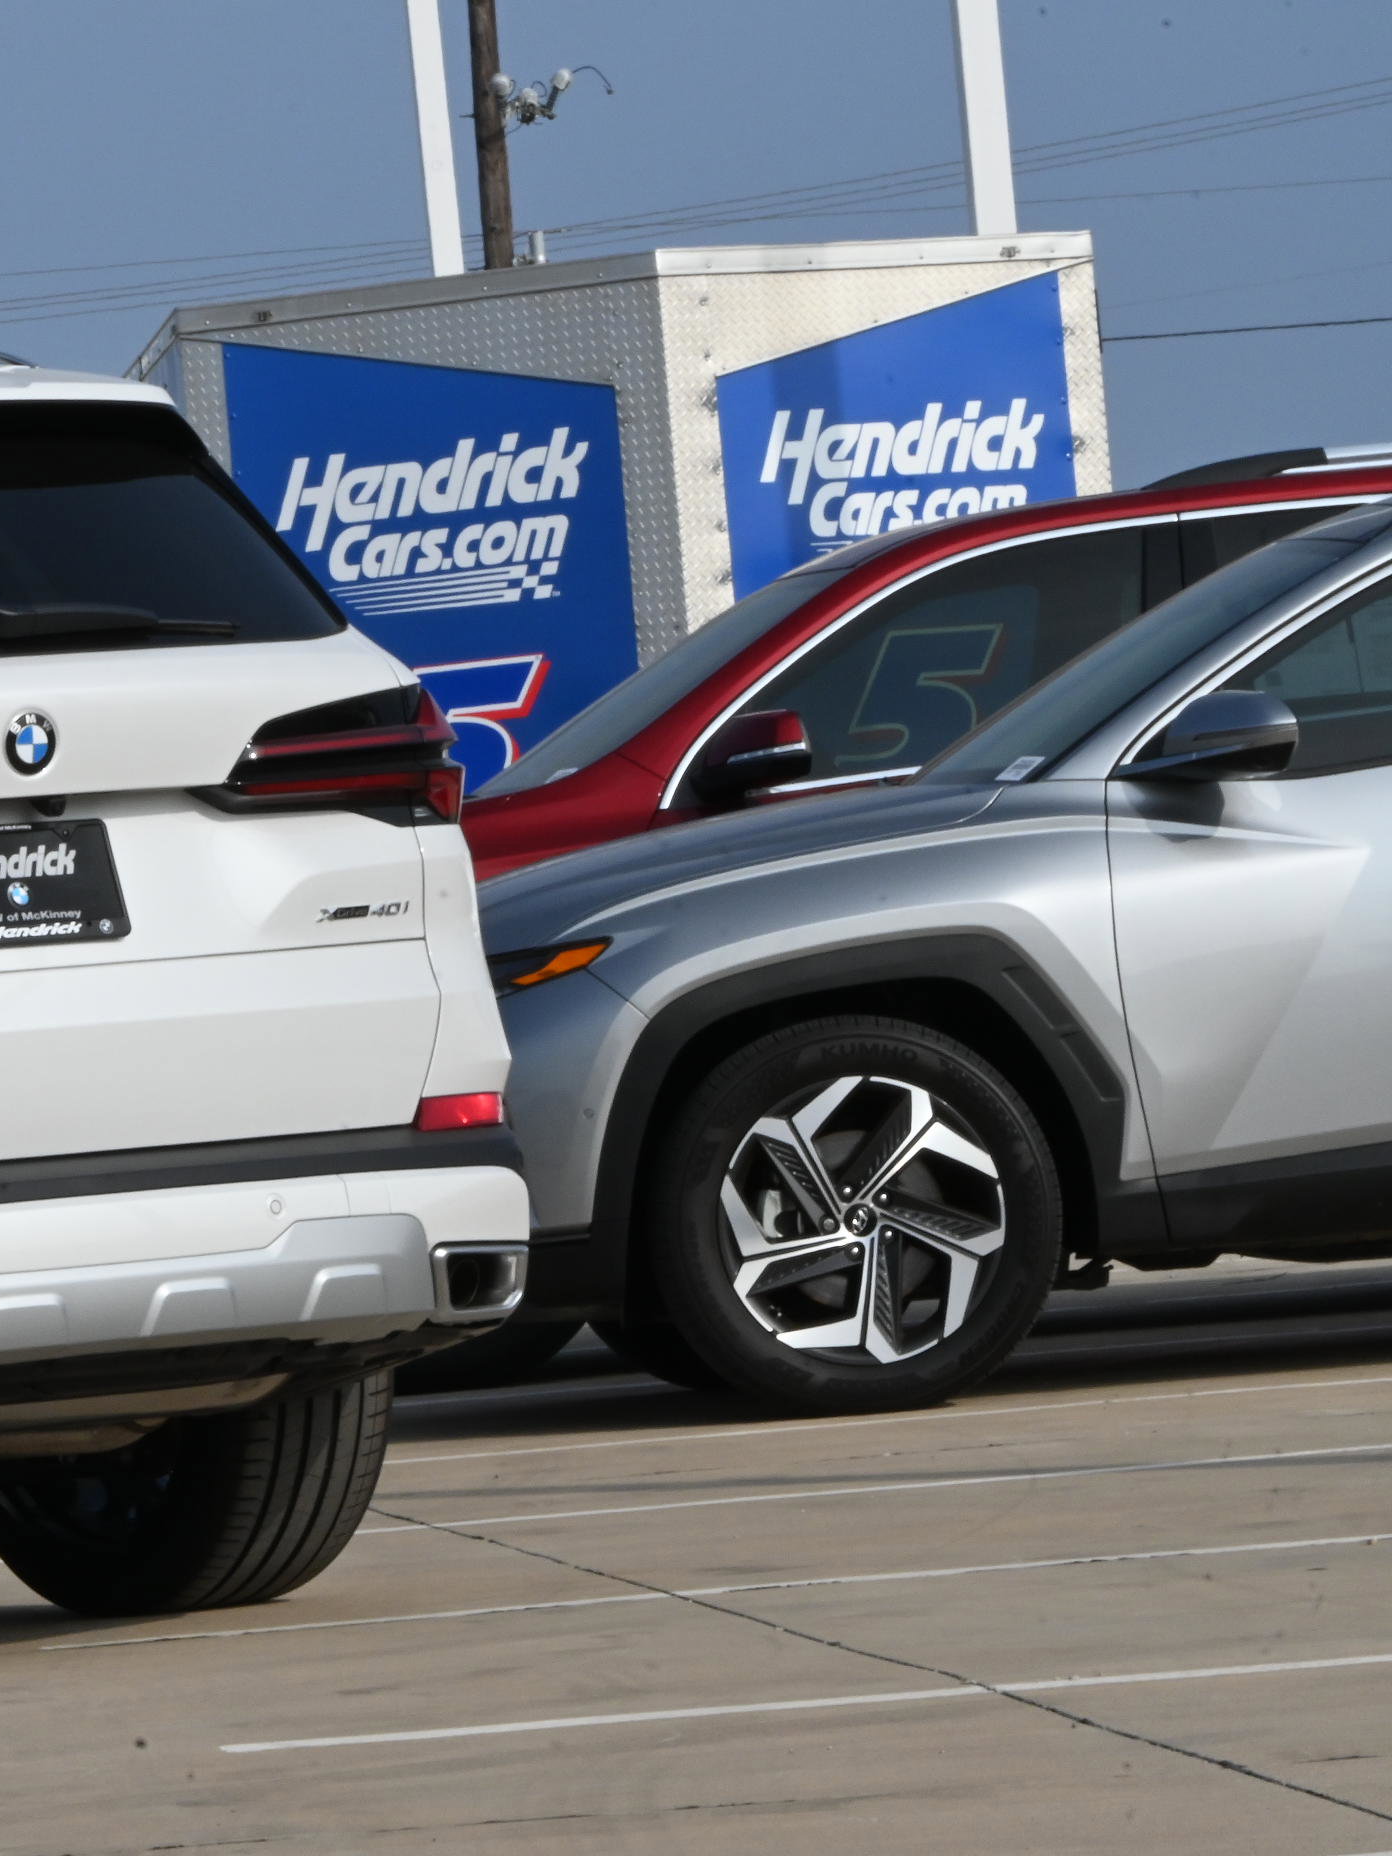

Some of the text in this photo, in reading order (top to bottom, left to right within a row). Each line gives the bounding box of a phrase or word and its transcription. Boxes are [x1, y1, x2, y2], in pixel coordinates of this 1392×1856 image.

[760, 398, 1045, 505] Hendrick
[276, 426, 589, 553] Hendrick
[329, 514, 569, 582] Cars.com
[6, 912, 19, 922] of
[21, 909, 82, 921] McKinney
[820, 1041, 919, 1062] KUMHO
